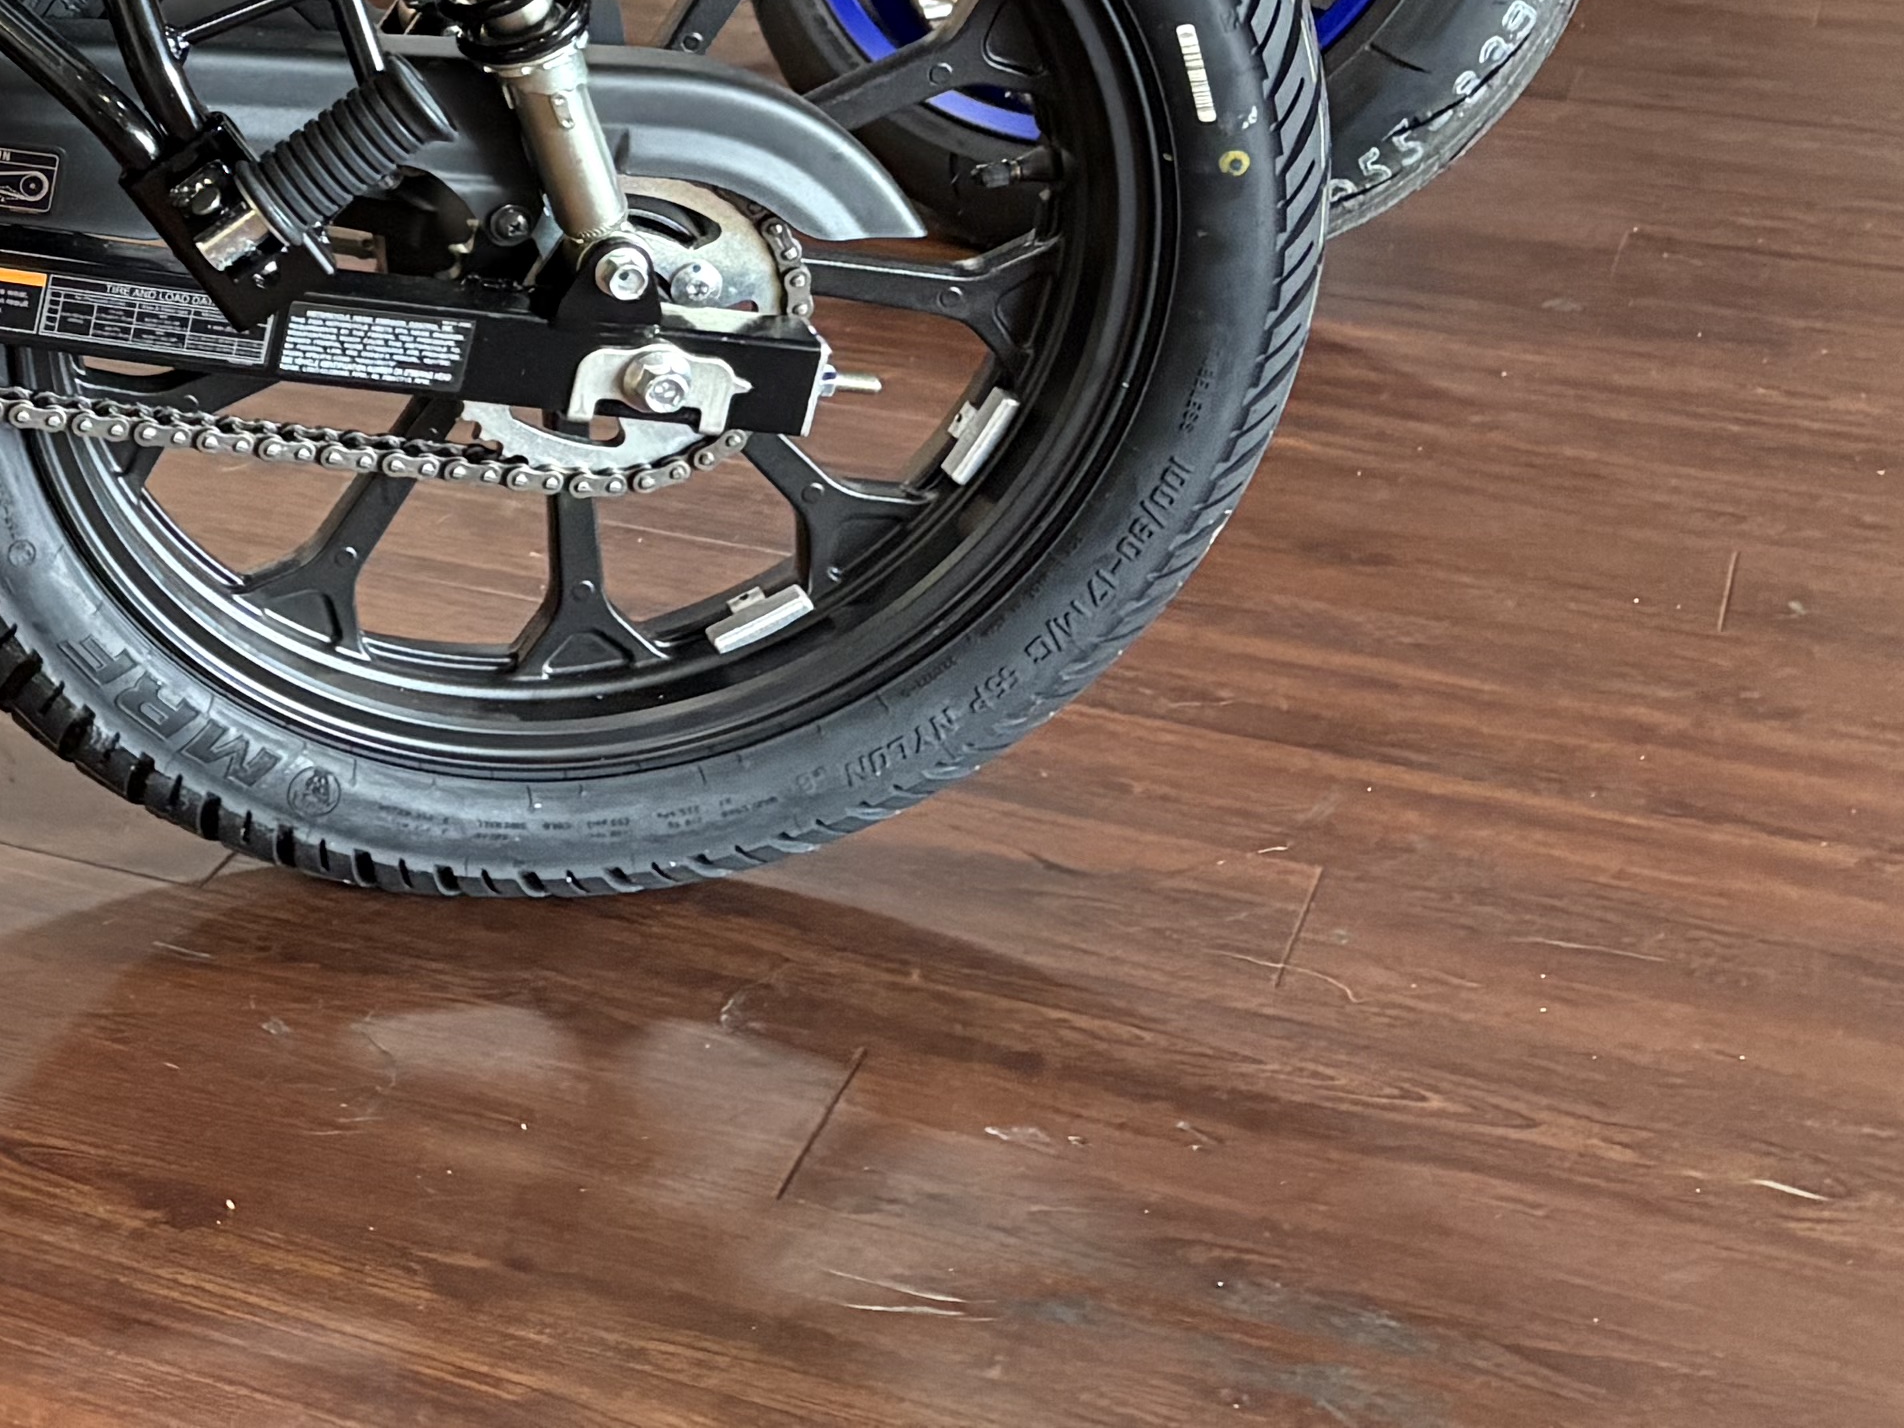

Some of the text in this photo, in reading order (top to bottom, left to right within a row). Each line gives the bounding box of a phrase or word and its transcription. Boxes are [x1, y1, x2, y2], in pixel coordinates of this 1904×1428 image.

[106, 284, 129, 297] TIRE
[132, 287, 156, 300] AND
[159, 291, 189, 303] LOAD
[59, 632, 285, 788] MRF
[844, 707, 954, 788] NYLON
